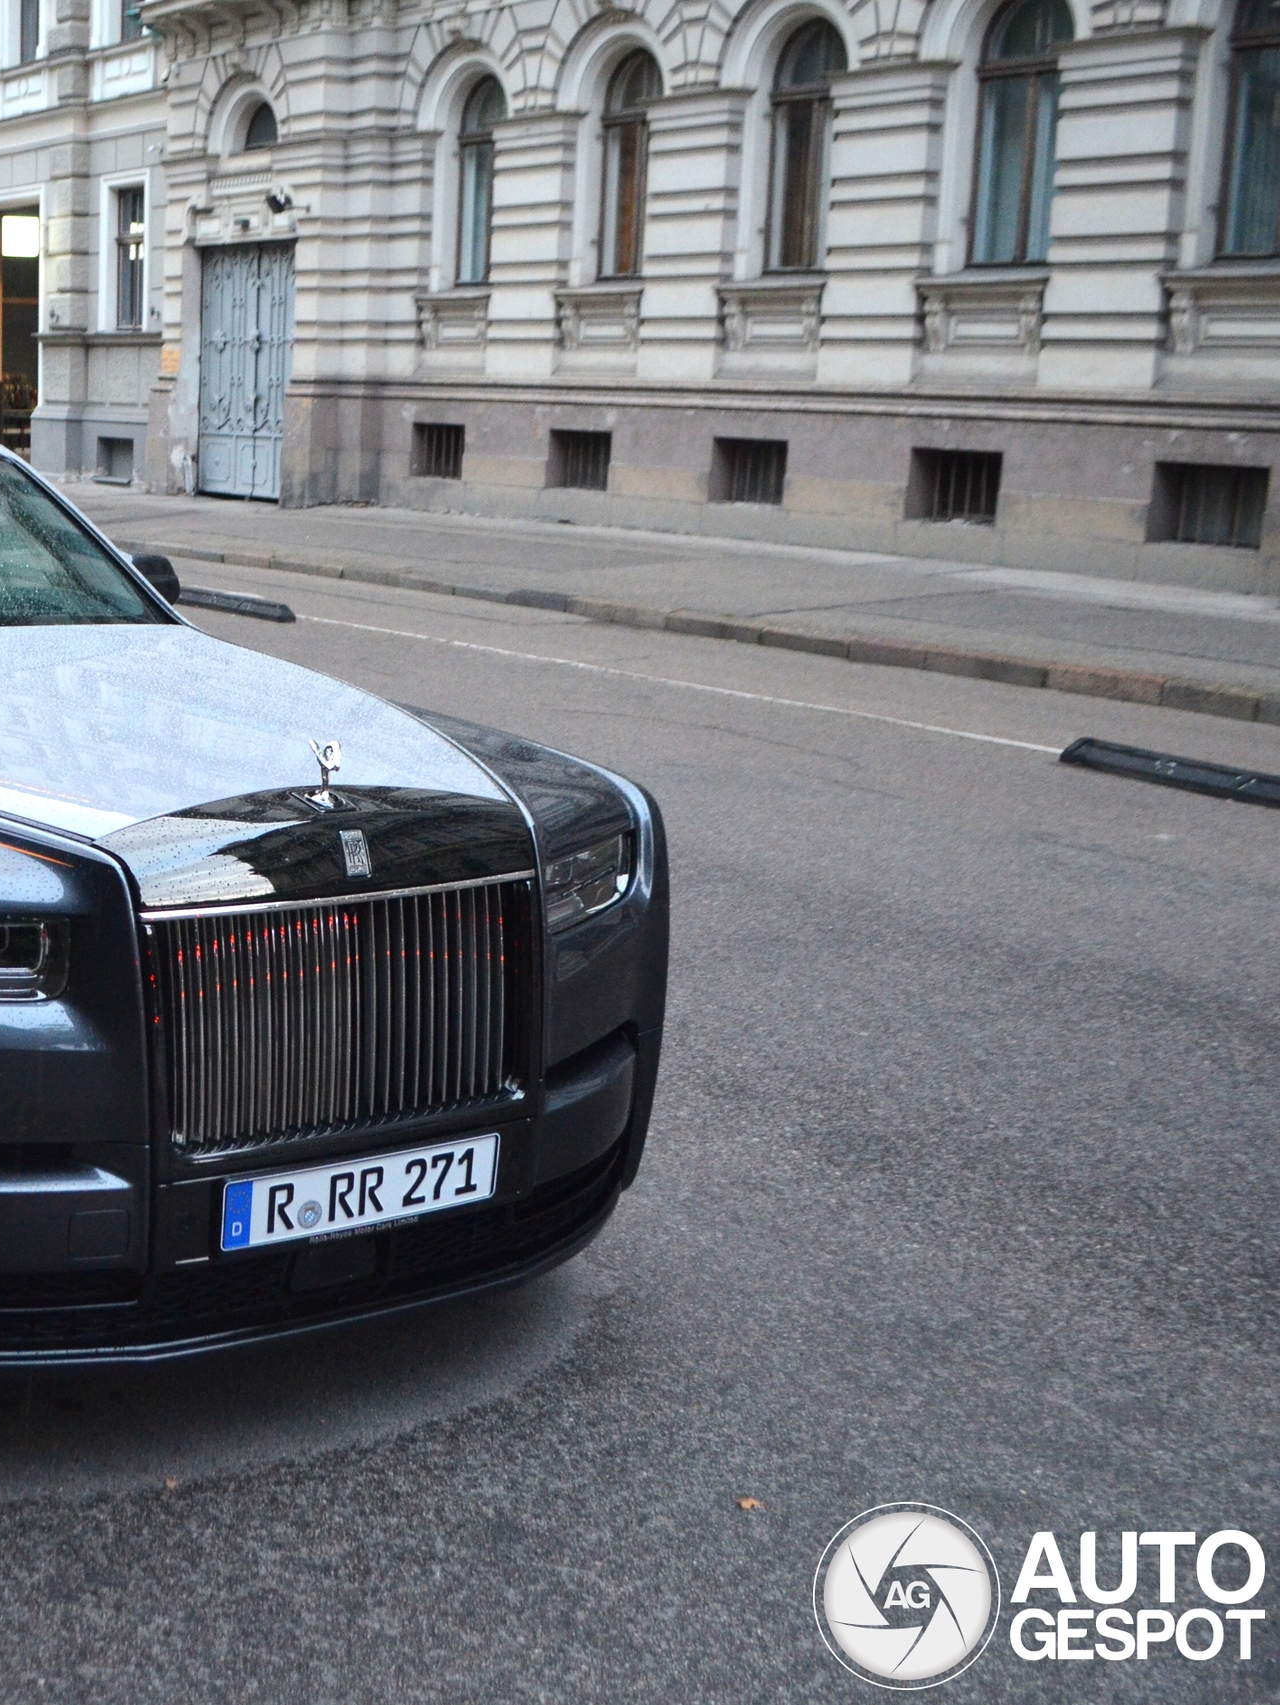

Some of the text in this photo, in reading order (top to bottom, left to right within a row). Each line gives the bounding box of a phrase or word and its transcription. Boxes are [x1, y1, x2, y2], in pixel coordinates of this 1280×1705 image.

[267, 1147, 478, 1233] R RR 271
[231, 1220, 243, 1236] D
[309, 1215, 419, 1243] Rolls-Royce Motor Cars Limited
